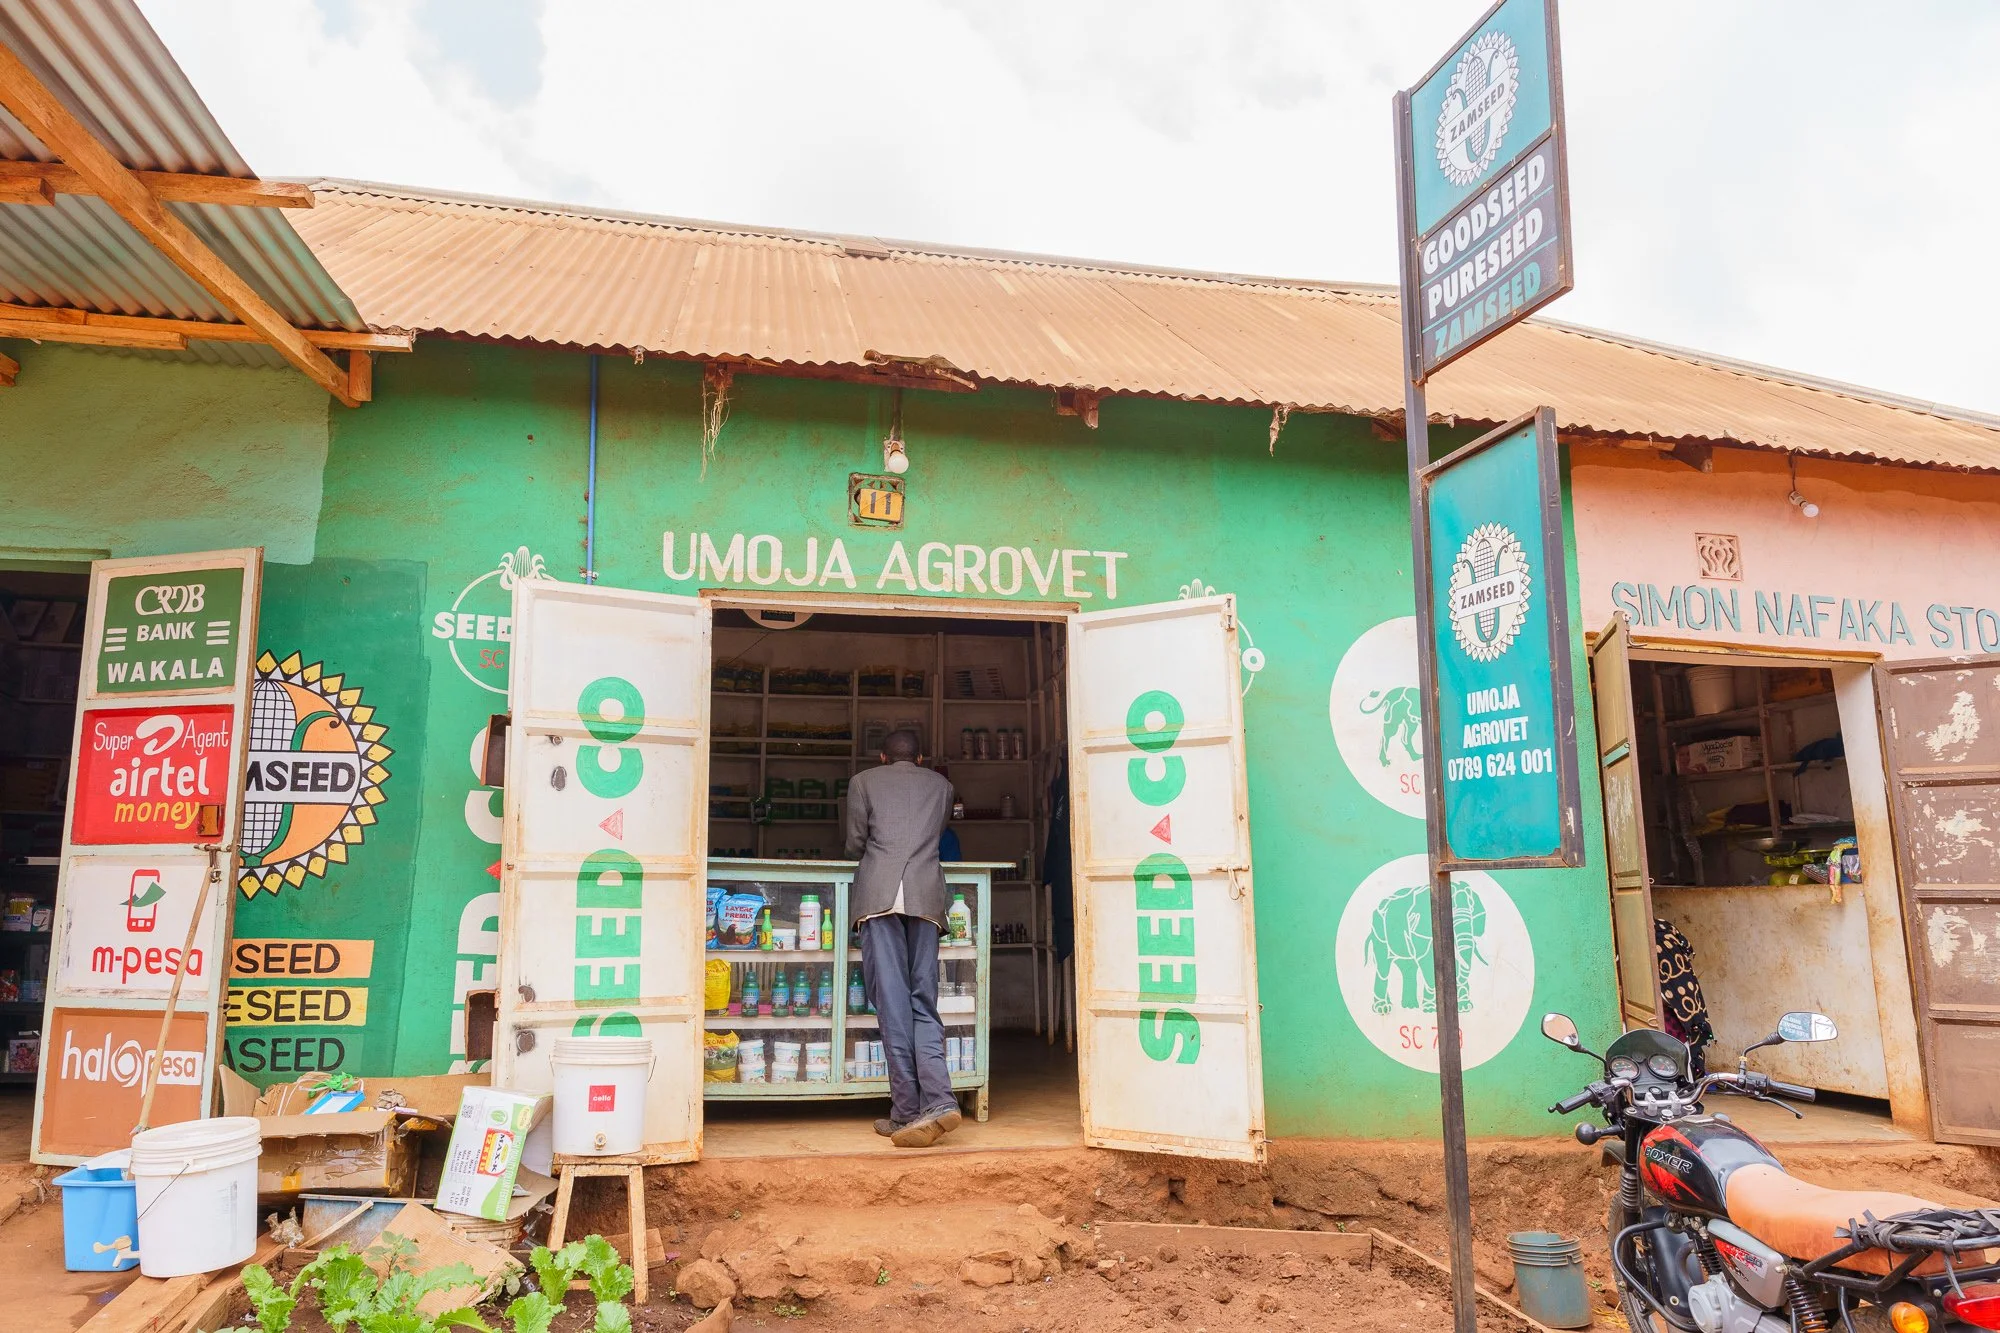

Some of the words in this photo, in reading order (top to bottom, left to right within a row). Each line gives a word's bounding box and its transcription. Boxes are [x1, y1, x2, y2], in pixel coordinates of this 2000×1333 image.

[1450, 83, 1505, 143] ZAMSEED
[1423, 154, 1546, 275] GOODSEED
[1428, 207, 1543, 320] PURESEED
[1435, 261, 1541, 357] ZAMSEED
[870, 491, 891, 515] 11
[662, 531, 857, 588] UMOJA
[876, 541, 1128, 599] AGROVET
[1460, 579, 1515, 610] ZAMSEED
[1611, 581, 1742, 632] SIMON
[1755, 591, 1916, 646] NAFAKA
[136, 622, 195, 643] BANK
[107, 657, 224, 684] WAKALA
[1467, 684, 1520, 715] UMOJA
[94, 722, 135, 759] Super
[181, 718, 229, 749] Agent
[576, 677, 645, 798] CO
[1126, 690, 1187, 806] CO
[1463, 716, 1529, 749] AGROVET
[109, 757, 210, 797] airtel
[1400, 773, 1421, 795] SC
[1447, 757, 1482, 782] 0789
[1486, 751, 1516, 777] 624
[1521, 748, 1553, 775] 001
[114, 800, 200, 830] money
[92, 946, 203, 985] m-pesa
[230, 943, 341, 974] SEED
[1133, 852, 1201, 1064] SEED
[1400, 1025, 1423, 1049] SC
[492, 1134, 505, 1172] MAX-K
[1645, 1145, 1693, 1173] BOXER
